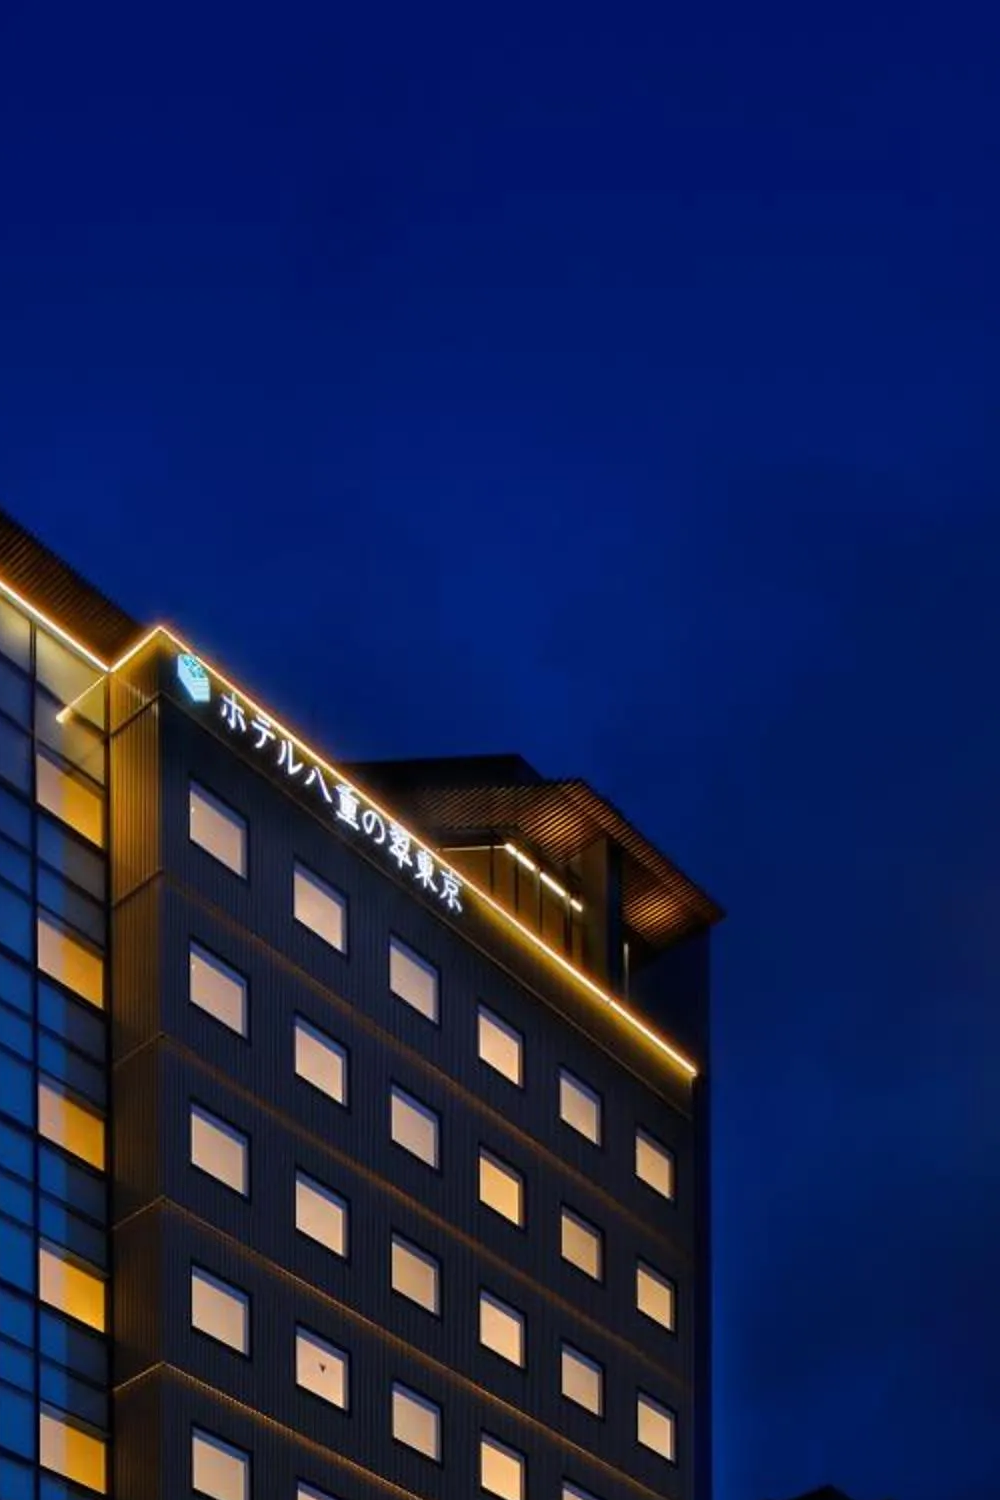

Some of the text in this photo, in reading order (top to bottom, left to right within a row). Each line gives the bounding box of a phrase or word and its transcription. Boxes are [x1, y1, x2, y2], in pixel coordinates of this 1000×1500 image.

[220, 694, 463, 913] ホテル八重の翠東京
